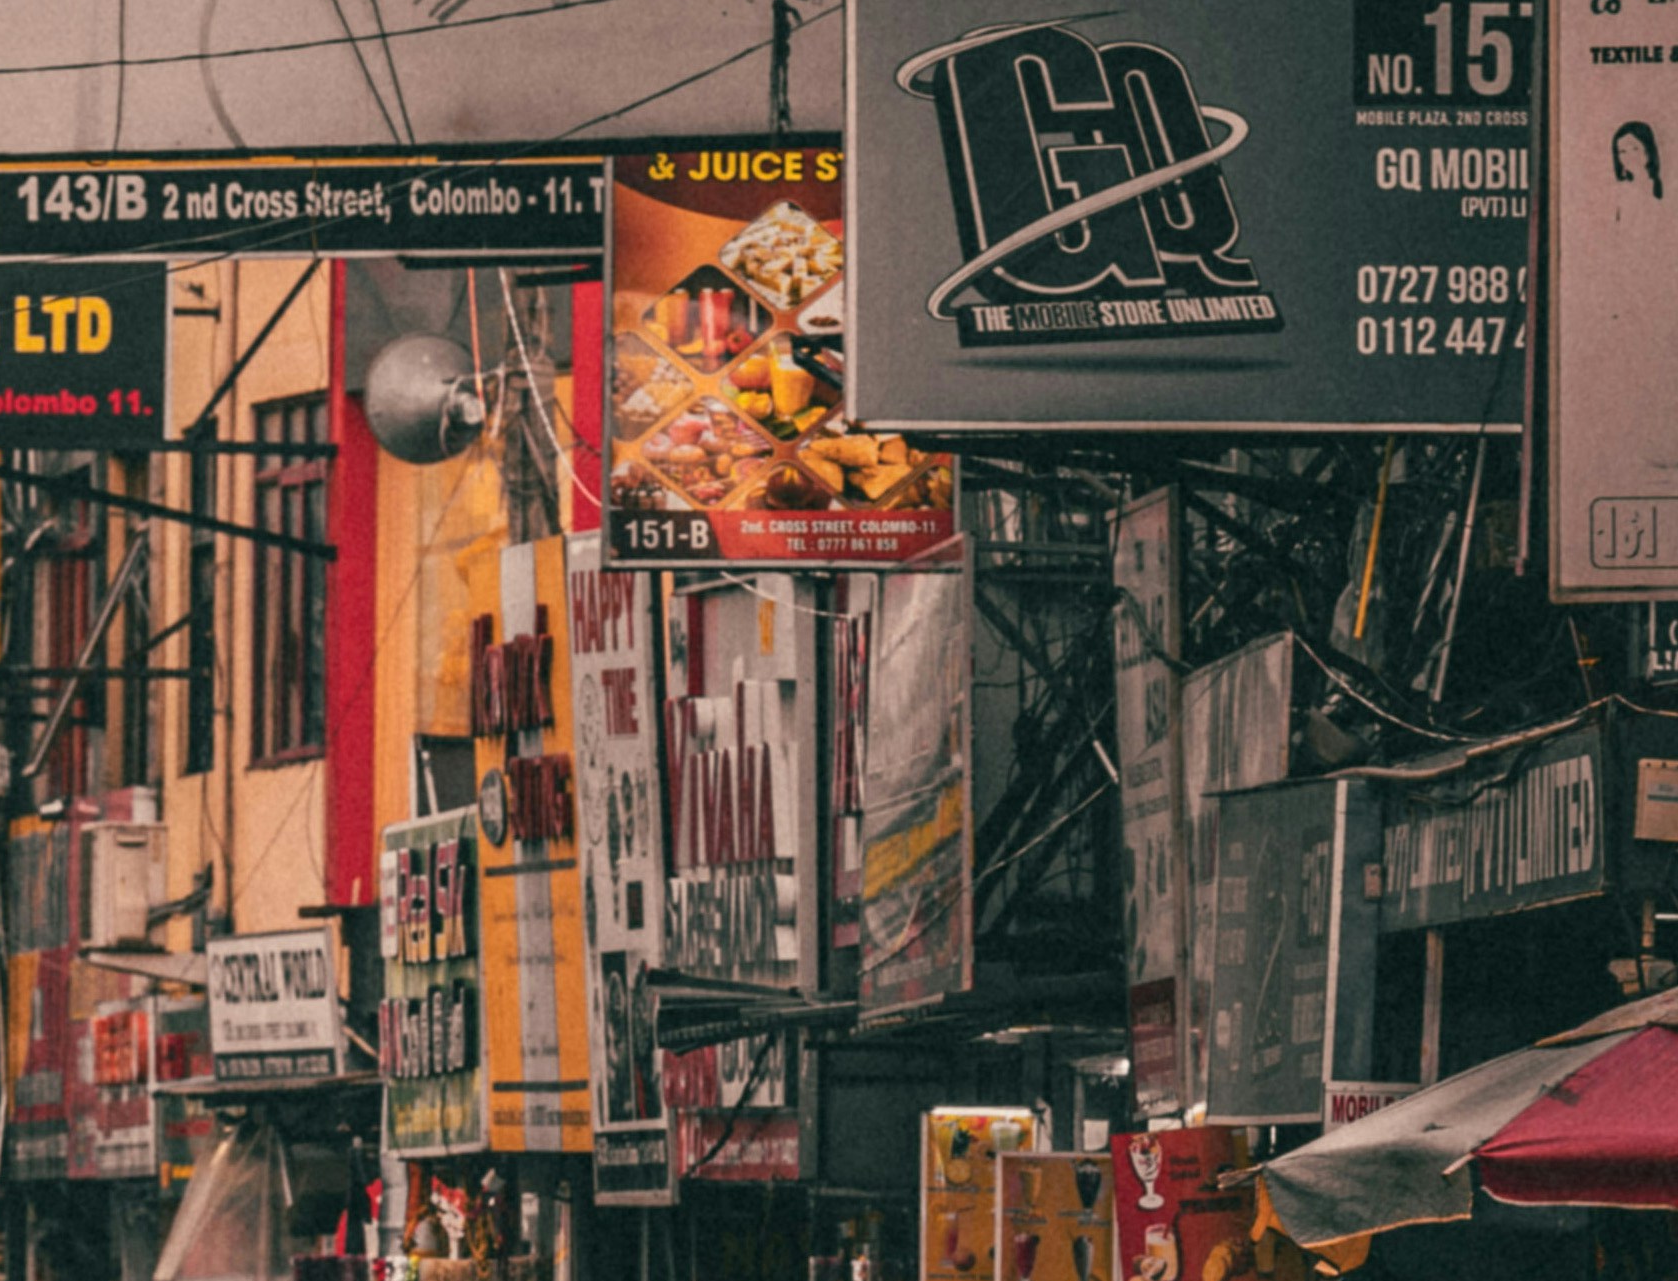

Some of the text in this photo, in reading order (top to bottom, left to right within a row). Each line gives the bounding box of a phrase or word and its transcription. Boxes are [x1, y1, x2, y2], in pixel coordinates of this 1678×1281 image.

[1590, 45, 1664, 65] TEXTILE
[1367, 55, 1423, 96] NO.
[1355, 110, 1406, 126] MOBILE
[1486, 110, 1529, 126] CROSS
[648, 152, 845, 182] & JUICE S
[1376, 148, 1422, 195] GQ
[17, 174, 585, 226] 143/B 2 nd Cross Street, Colombo 11.
[1460, 195, 1508, 219] (PVT)
[1356, 264, 1509, 304] 0727 988
[14, 295, 114, 355] LTD
[972, 303, 1013, 332] THE
[1099, 297, 1165, 327] STORE
[1166, 292, 1279, 325] UNLIMITED
[1356, 315, 1507, 356] 0112 447
[107, 390, 154, 417] 11.
[625, 519, 710, 550] 151-B
[769, 520, 809, 536] CROSS
[787, 538, 809, 552] TEL
[571, 570, 635, 655] HAPPY
